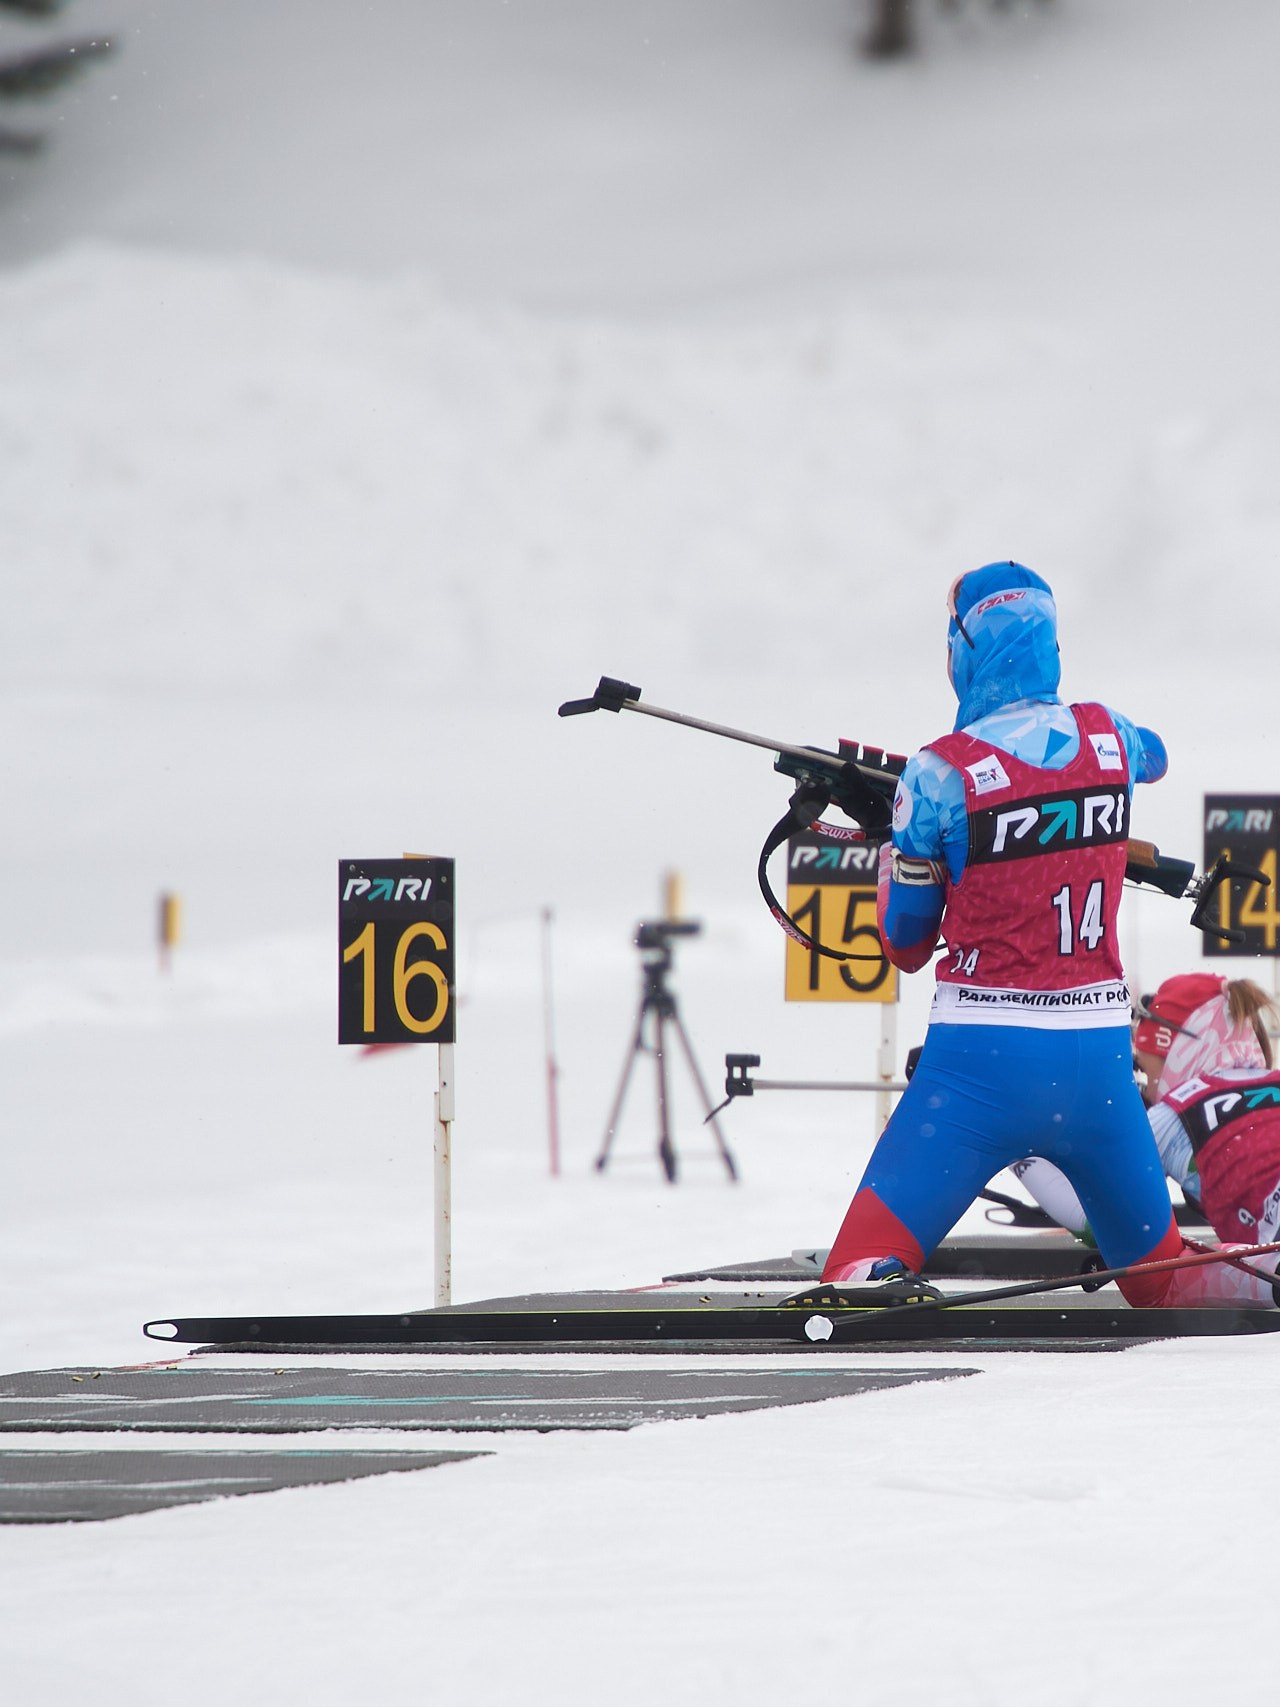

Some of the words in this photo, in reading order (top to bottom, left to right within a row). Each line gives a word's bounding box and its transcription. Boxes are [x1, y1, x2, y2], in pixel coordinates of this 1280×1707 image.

[992, 793, 1125, 853] PARI
[1206, 809, 1273, 832] PARI
[818, 825, 855, 840] SWIX
[790, 846, 878, 869] PARI
[343, 878, 432, 901] PARI
[1052, 881, 1105, 956] 14
[792, 888, 890, 993] 15
[343, 921, 449, 1034] 16
[1000, 992, 1102, 1006] ЧЕМПИОНАТ
